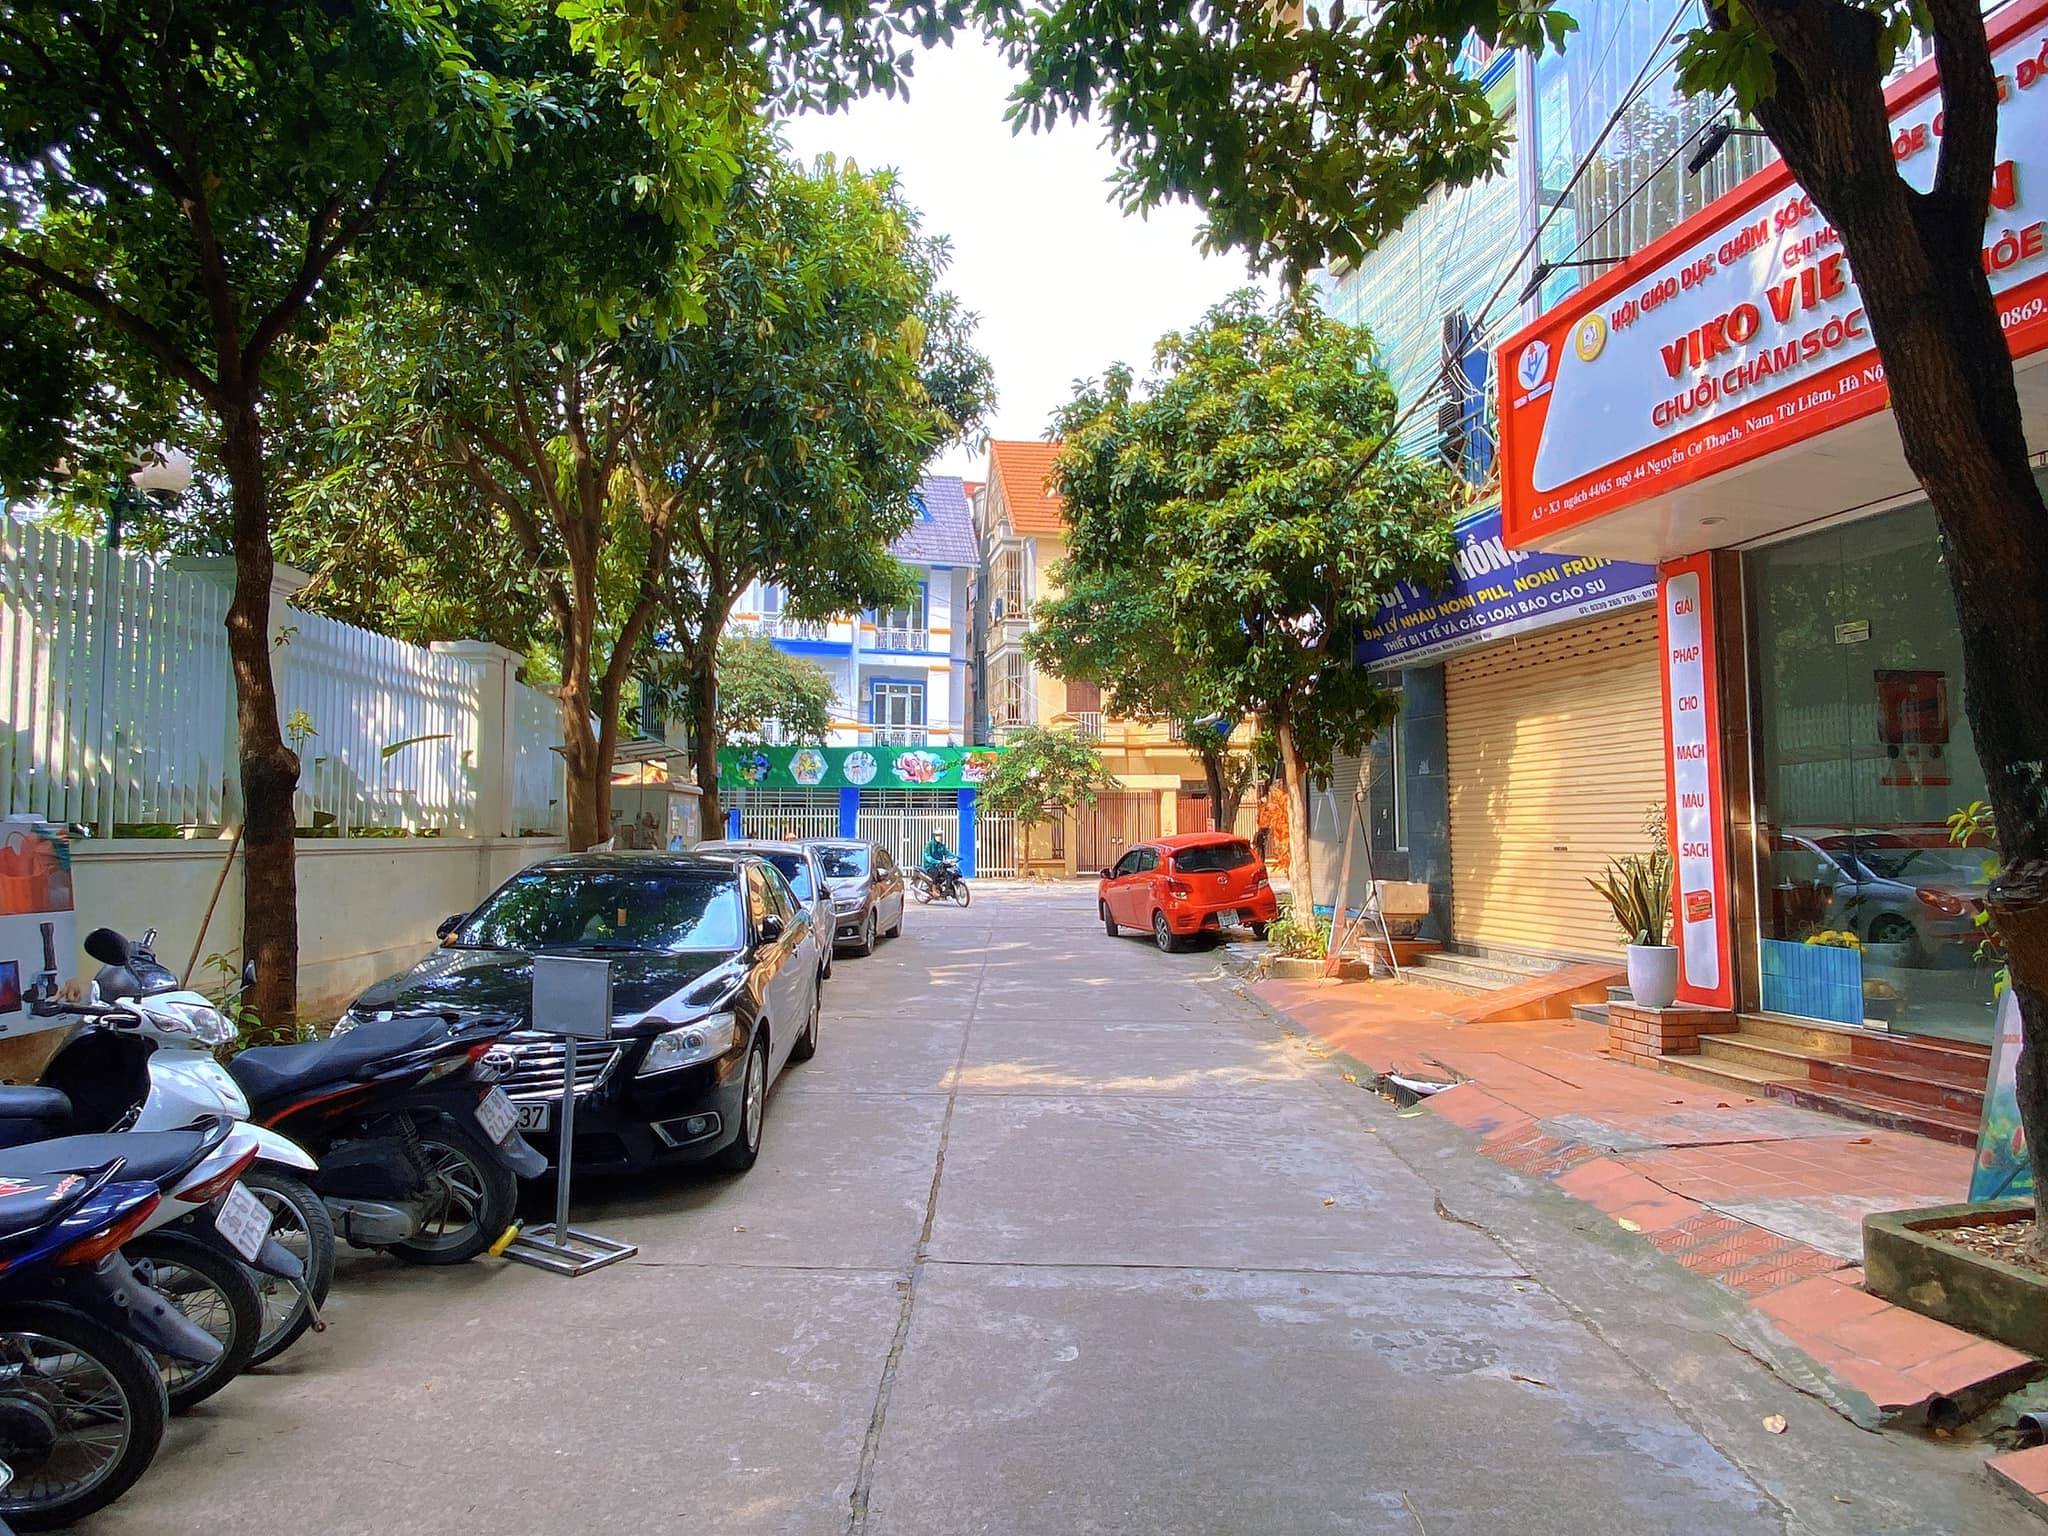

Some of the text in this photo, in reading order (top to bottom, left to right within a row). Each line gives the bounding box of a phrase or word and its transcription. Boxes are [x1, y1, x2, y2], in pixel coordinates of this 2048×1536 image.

[1782, 236, 1811, 269] CHI
[1612, 300, 1637, 330] HỘI
[1641, 277, 1678, 311] GIÁO
[1681, 253, 1715, 290] DỤC
[1718, 218, 1768, 265] CHĂM
[1660, 303, 1760, 378] VIKO
[1652, 374, 1719, 427] CHUỖI
[1722, 340, 1798, 394] CHĂM
[1531, 506, 1542, 520] A3
[1549, 500, 1560, 515] X3
[1563, 489, 1588, 510] ngách
[1588, 478, 1612, 498] 44/65
[1615, 471, 1632, 488] ngõ
[1634, 464, 1645, 479] 44
[1647, 448, 1684, 475] Nguyễn
[1687, 441, 1703, 457] Cơ
[1703, 426, 1743, 452] Thạch,
[1746, 412, 1774, 435] Nam
[1777, 402, 1796, 420] Từ
[1798, 390, 1836, 412] Liêm,
[1838, 375, 1860, 395] Hà
[1863, 363, 1885, 385] Nộ
[1363, 625, 1384, 641] ĐẠI
[1400, 608, 1436, 629] NHÀU
[1438, 594, 1476, 616] NONI
[1476, 584, 1513, 605] PILL,
[1513, 567, 1560, 592] NONI
[1383, 634, 1408, 653] THIẾT
[1408, 633, 1421, 646] BỊ
[1420, 631, 1427, 642] Y
[1428, 623, 1441, 639] TẾ
[1441, 620, 1459, 635] VÀ
[1459, 614, 1486, 630] CÁC
[1487, 604, 1518, 623] LOẠI
[1518, 596, 1547, 613] BAO
[1550, 586, 1583, 604] CAO
[1585, 579, 1606, 594] SU
[1675, 595, 1693, 615] GIẢI
[1673, 644, 1699, 664] PHÁP
[1678, 695, 1698, 711] CHO
[1677, 744, 1704, 762] MẠCH
[1682, 791, 1705, 808] MÁU
[1682, 842, 1709, 860] SẠCH
